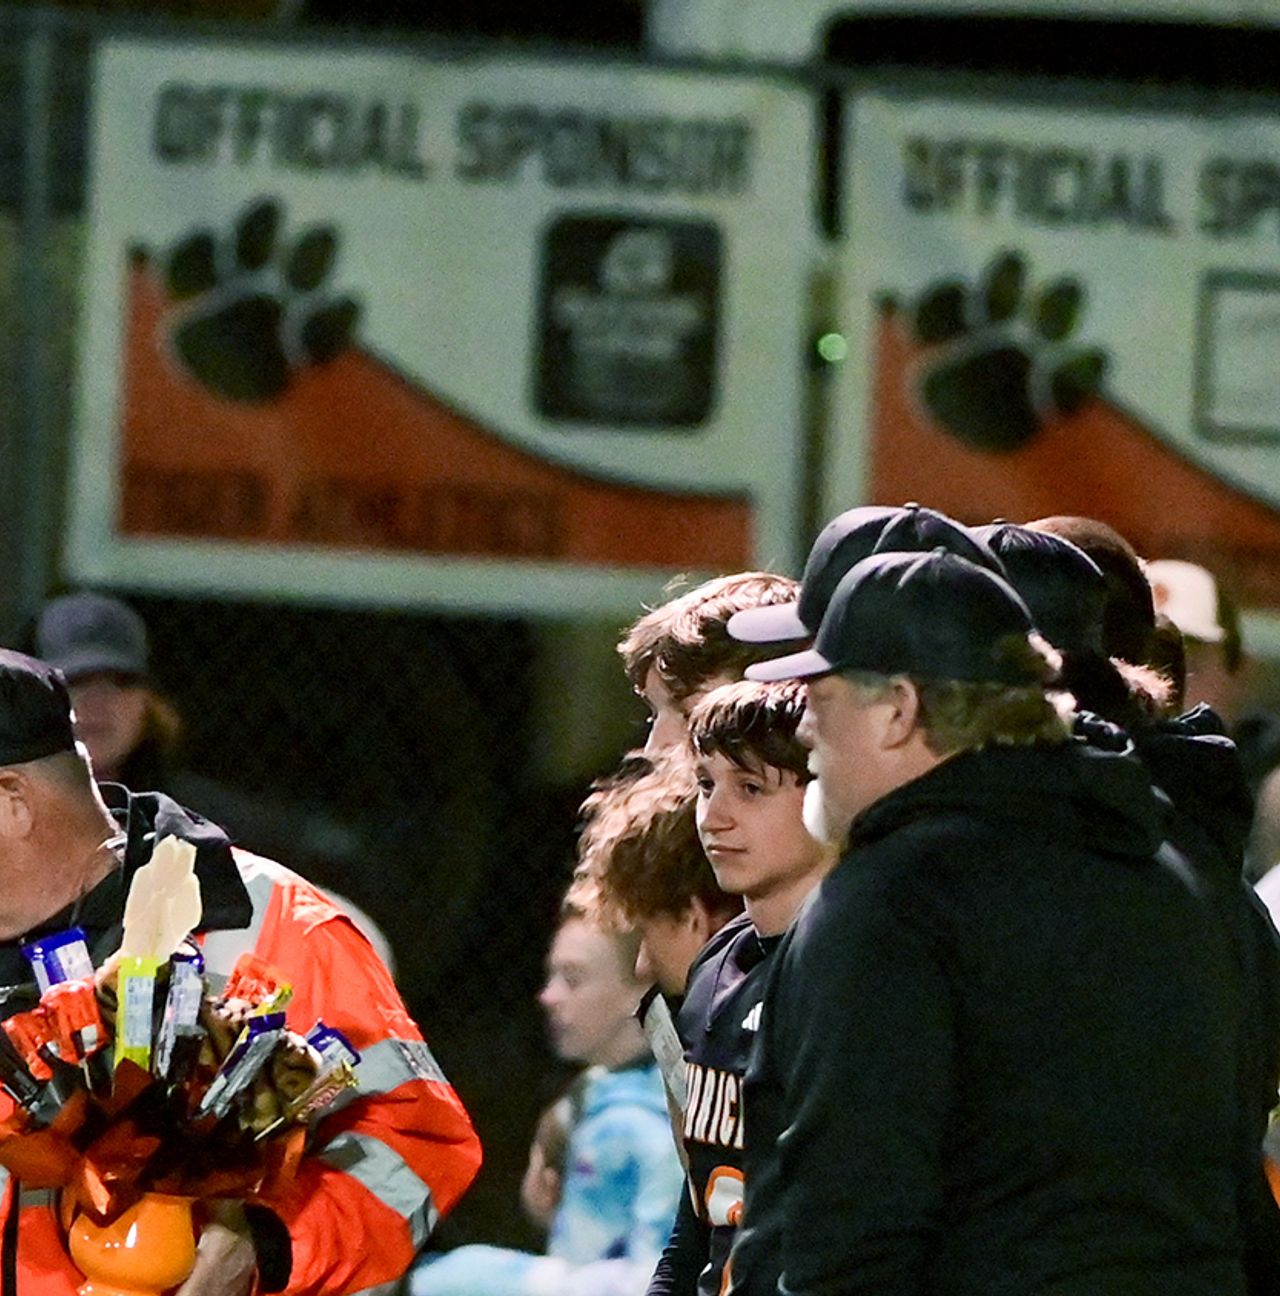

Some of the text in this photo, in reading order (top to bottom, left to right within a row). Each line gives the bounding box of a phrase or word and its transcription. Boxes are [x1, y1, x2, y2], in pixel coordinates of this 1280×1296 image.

[153, 84, 751, 197] OFFICIAL SPONSOR
[903, 134, 1174, 237] OFFICIAL
